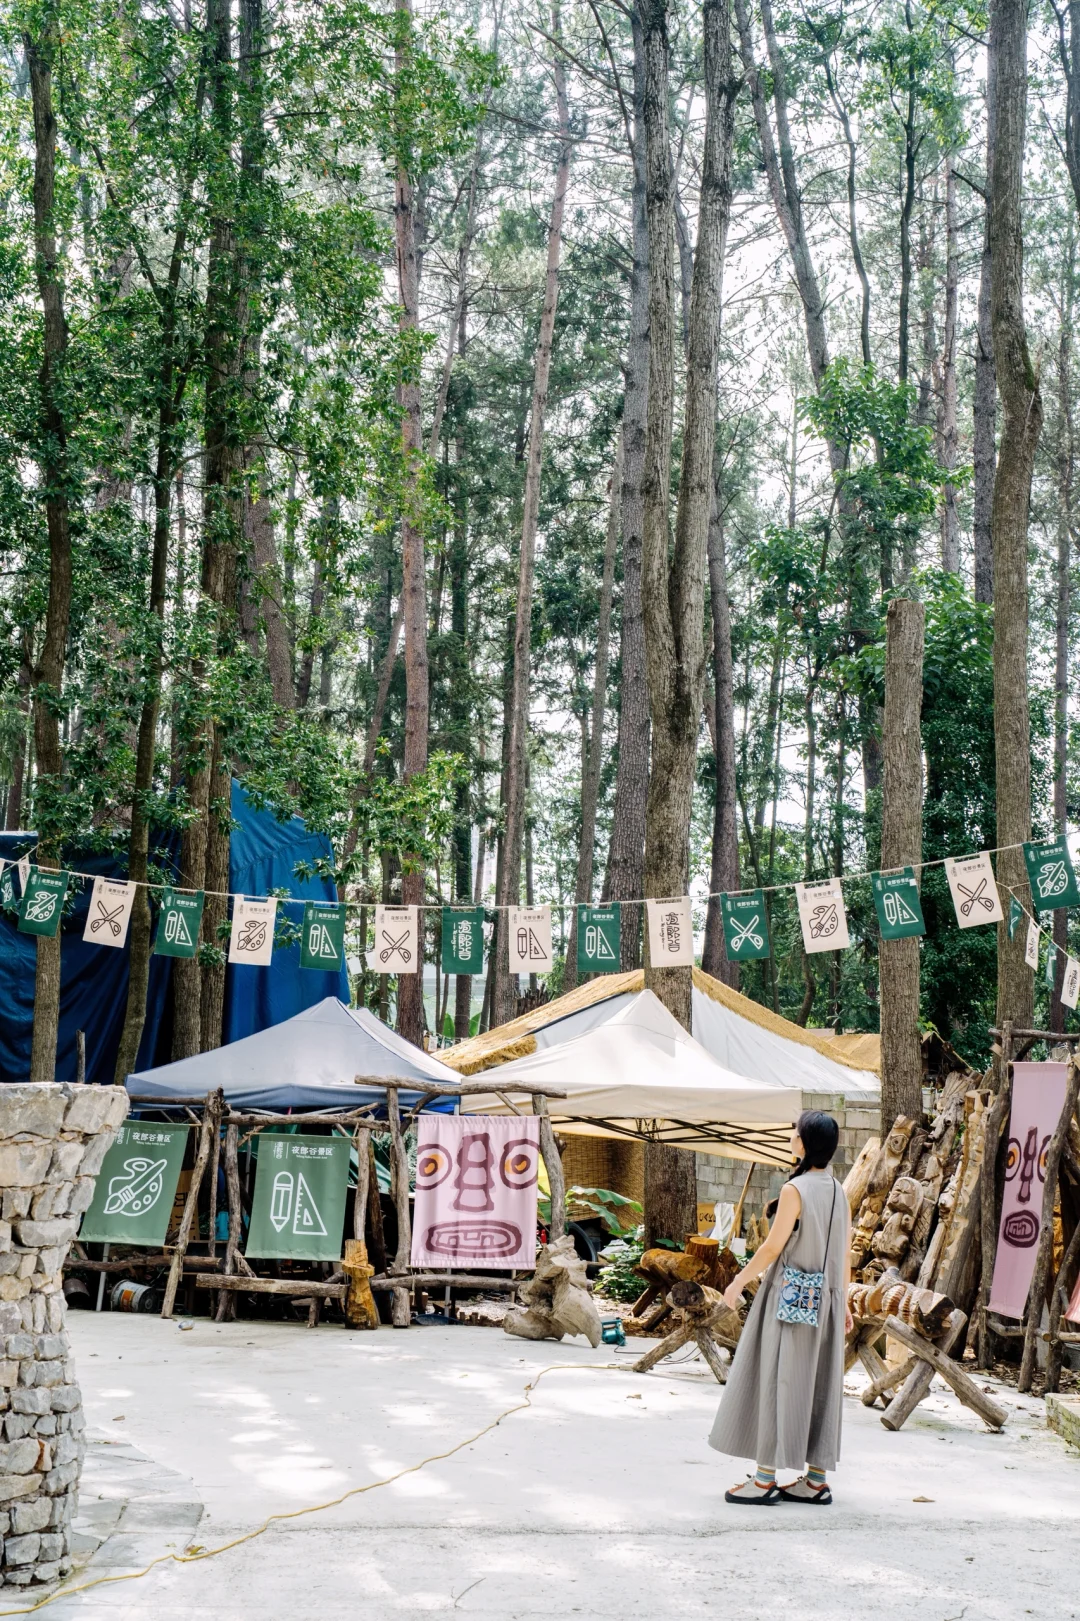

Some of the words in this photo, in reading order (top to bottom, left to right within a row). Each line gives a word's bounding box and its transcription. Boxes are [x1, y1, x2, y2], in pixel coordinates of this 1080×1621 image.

[132, 1132, 171, 1143] 夜郎谷景区
[292, 1146, 333, 1156] 夜郎谷景区
